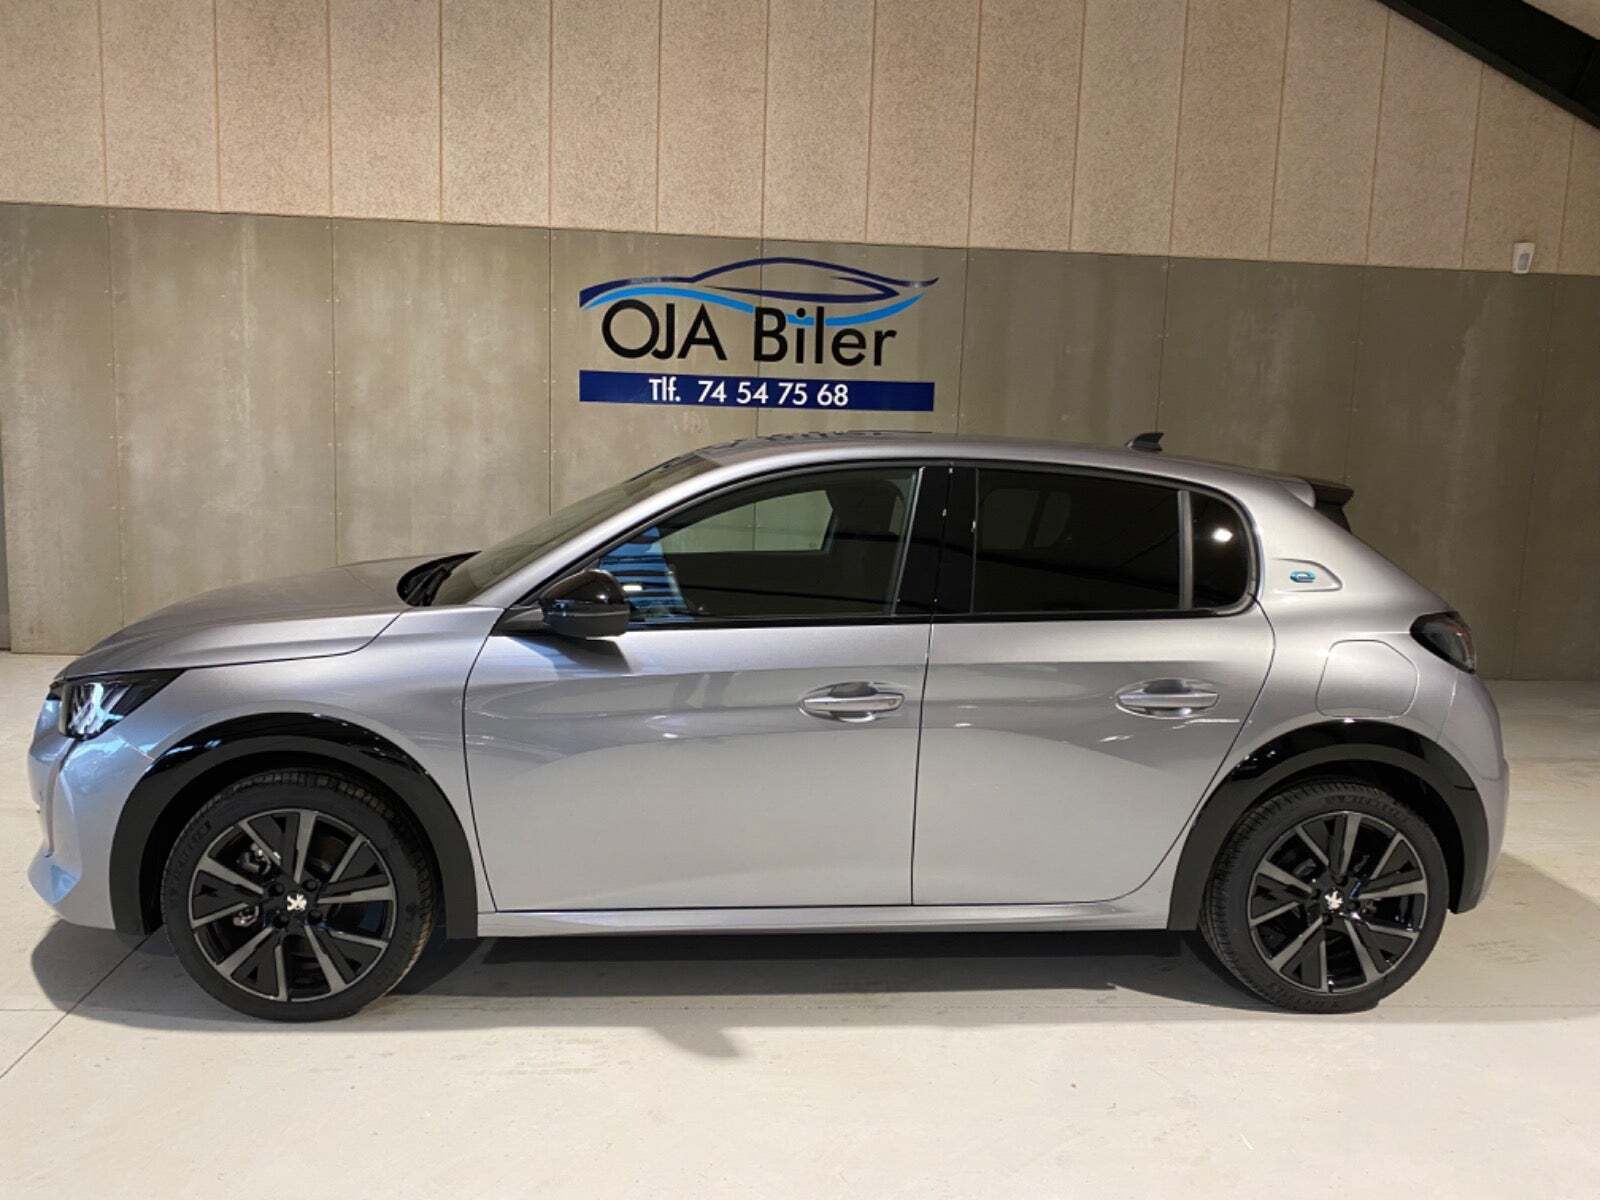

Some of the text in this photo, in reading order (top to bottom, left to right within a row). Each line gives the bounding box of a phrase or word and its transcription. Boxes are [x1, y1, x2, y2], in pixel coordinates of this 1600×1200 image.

[601, 299, 898, 367] OJA Biler
[648, 375, 849, 407] Tlf. 74 54 75 68
